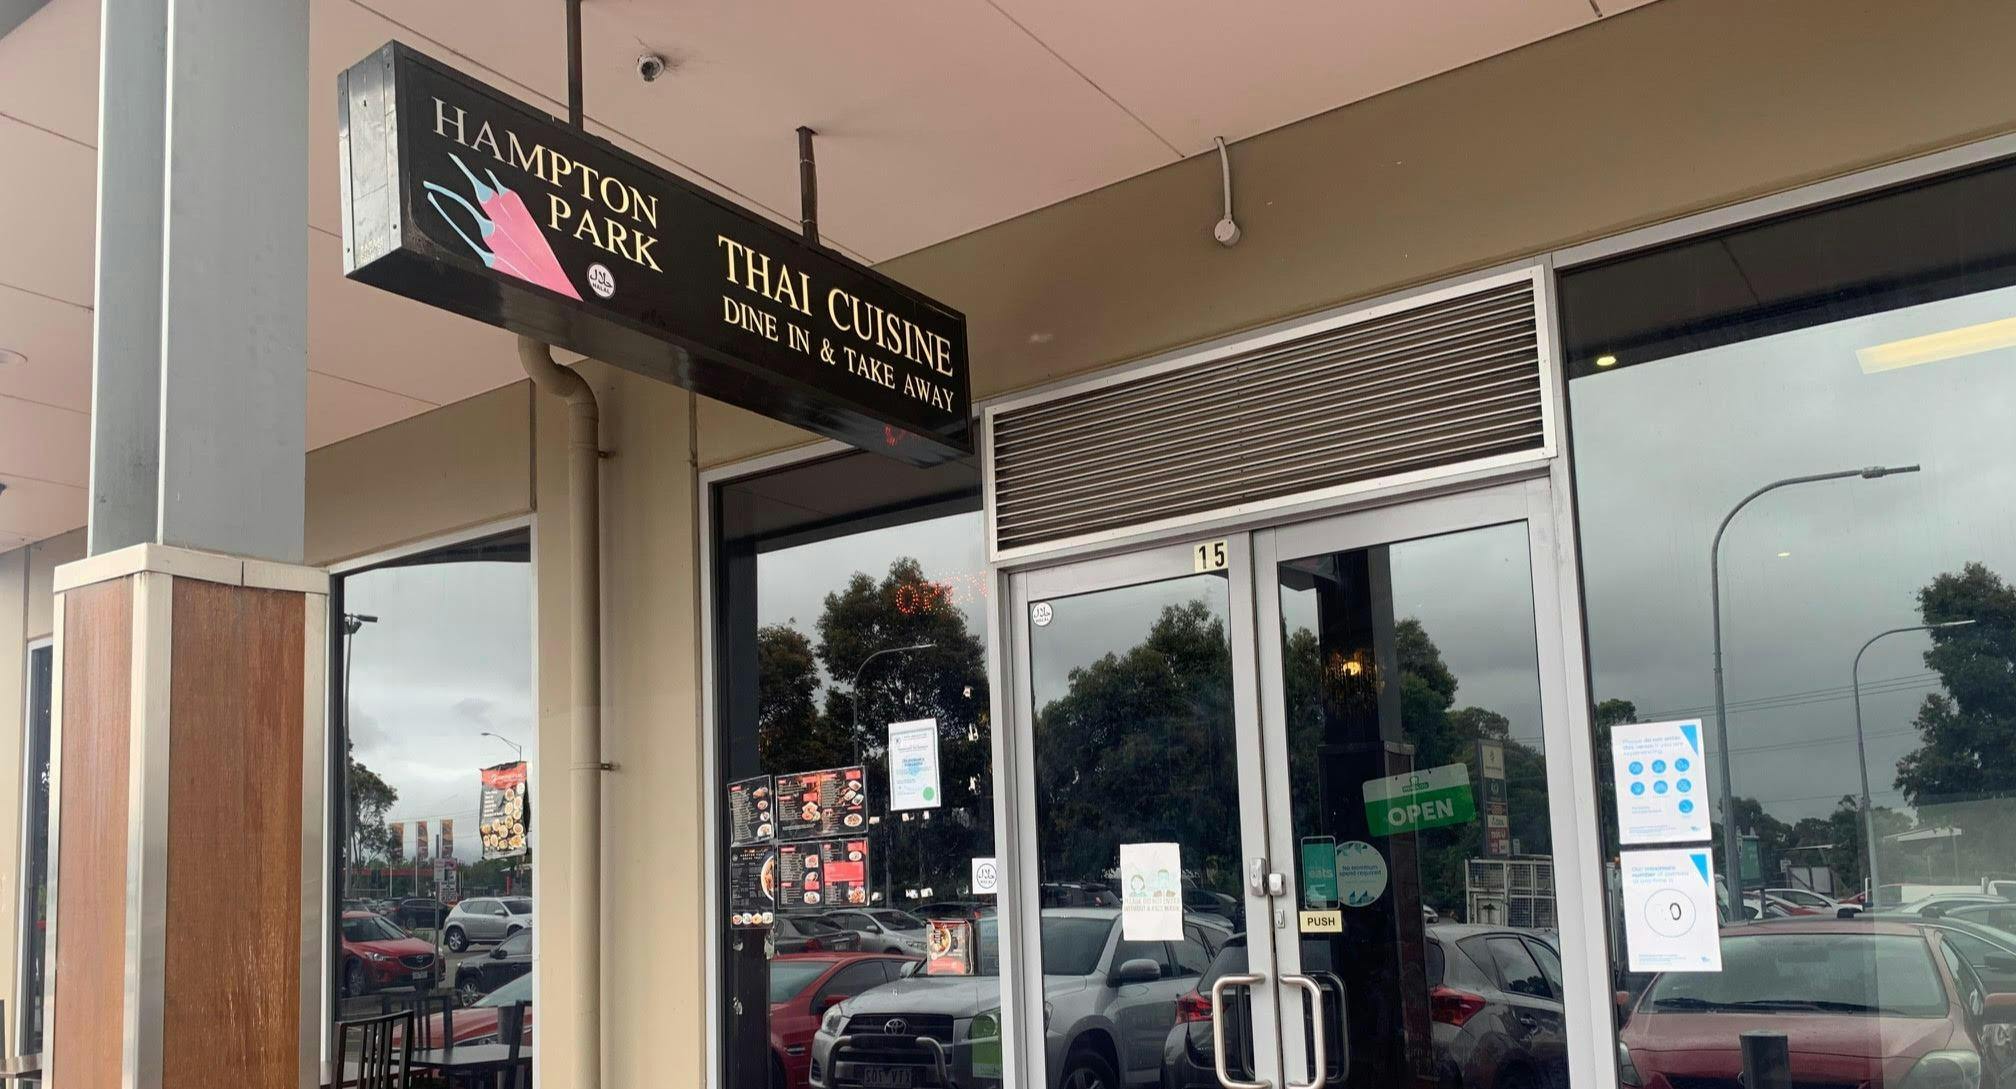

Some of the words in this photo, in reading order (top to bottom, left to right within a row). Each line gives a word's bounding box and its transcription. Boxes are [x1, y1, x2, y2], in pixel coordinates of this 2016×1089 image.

[432, 96, 658, 229] HAMPTON
[547, 193, 663, 273] PARK
[590, 269, 612, 288] حلال
[592, 282, 611, 294] HALAL
[718, 235, 812, 316] THAI
[828, 288, 953, 377] CUISINE
[722, 295, 779, 342] DINE
[787, 322, 811, 355] IN
[820, 337, 836, 365] &
[843, 346, 896, 389] TAKE
[903, 373, 954, 413] AWAY
[1198, 542, 1225, 570] 15
[896, 569, 988, 614] OPEN
[1387, 799, 1454, 826] OPEN
[1307, 917, 1335, 926] PUSH
